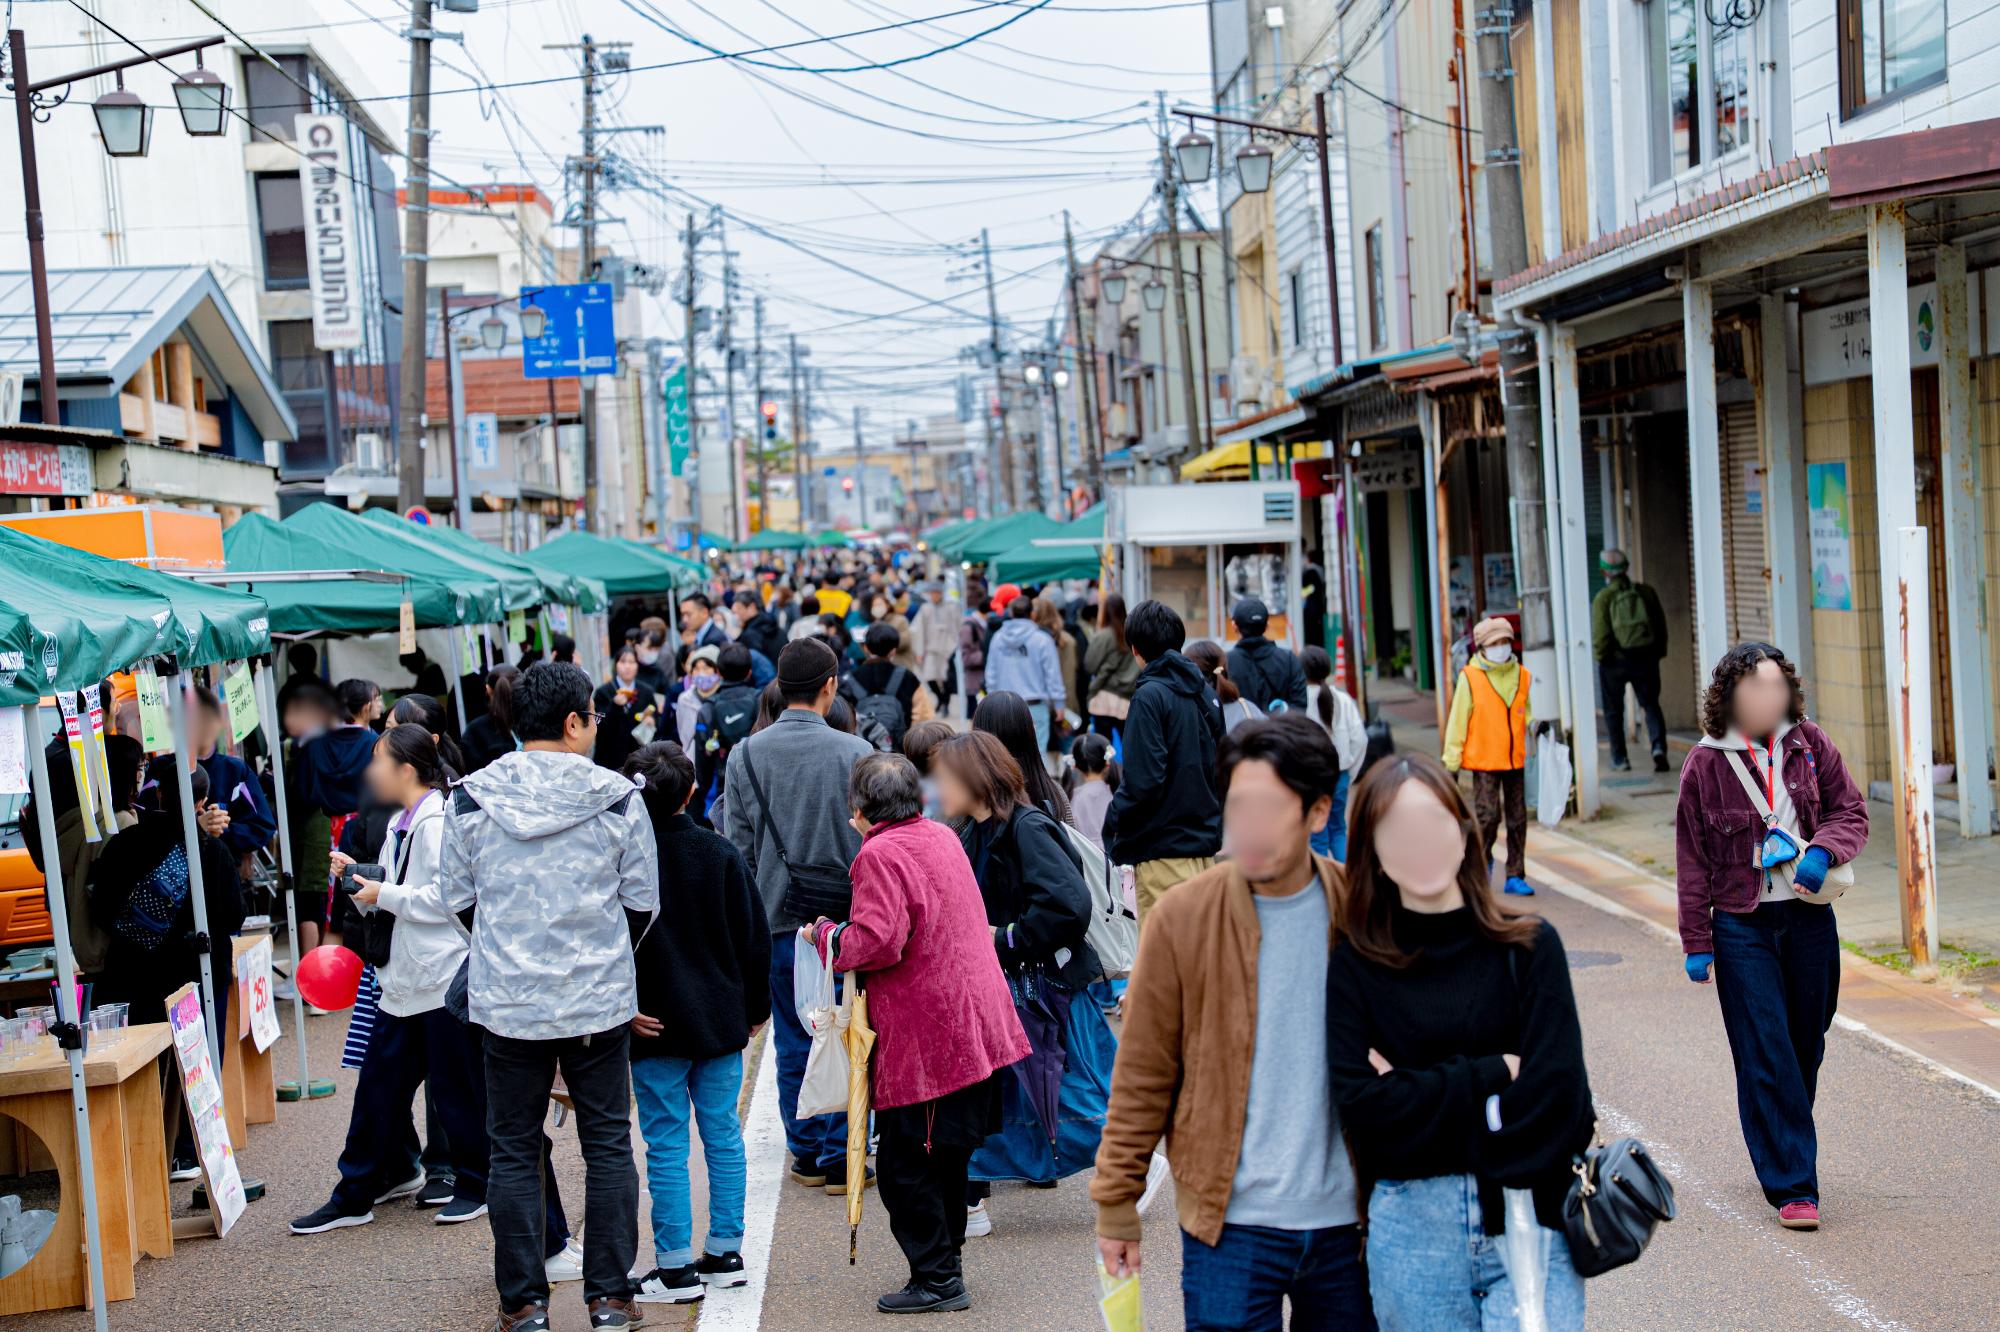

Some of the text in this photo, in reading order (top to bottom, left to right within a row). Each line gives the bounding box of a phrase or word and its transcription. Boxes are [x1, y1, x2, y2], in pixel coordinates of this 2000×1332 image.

[0, 447, 60, 488] 本町サービス店
